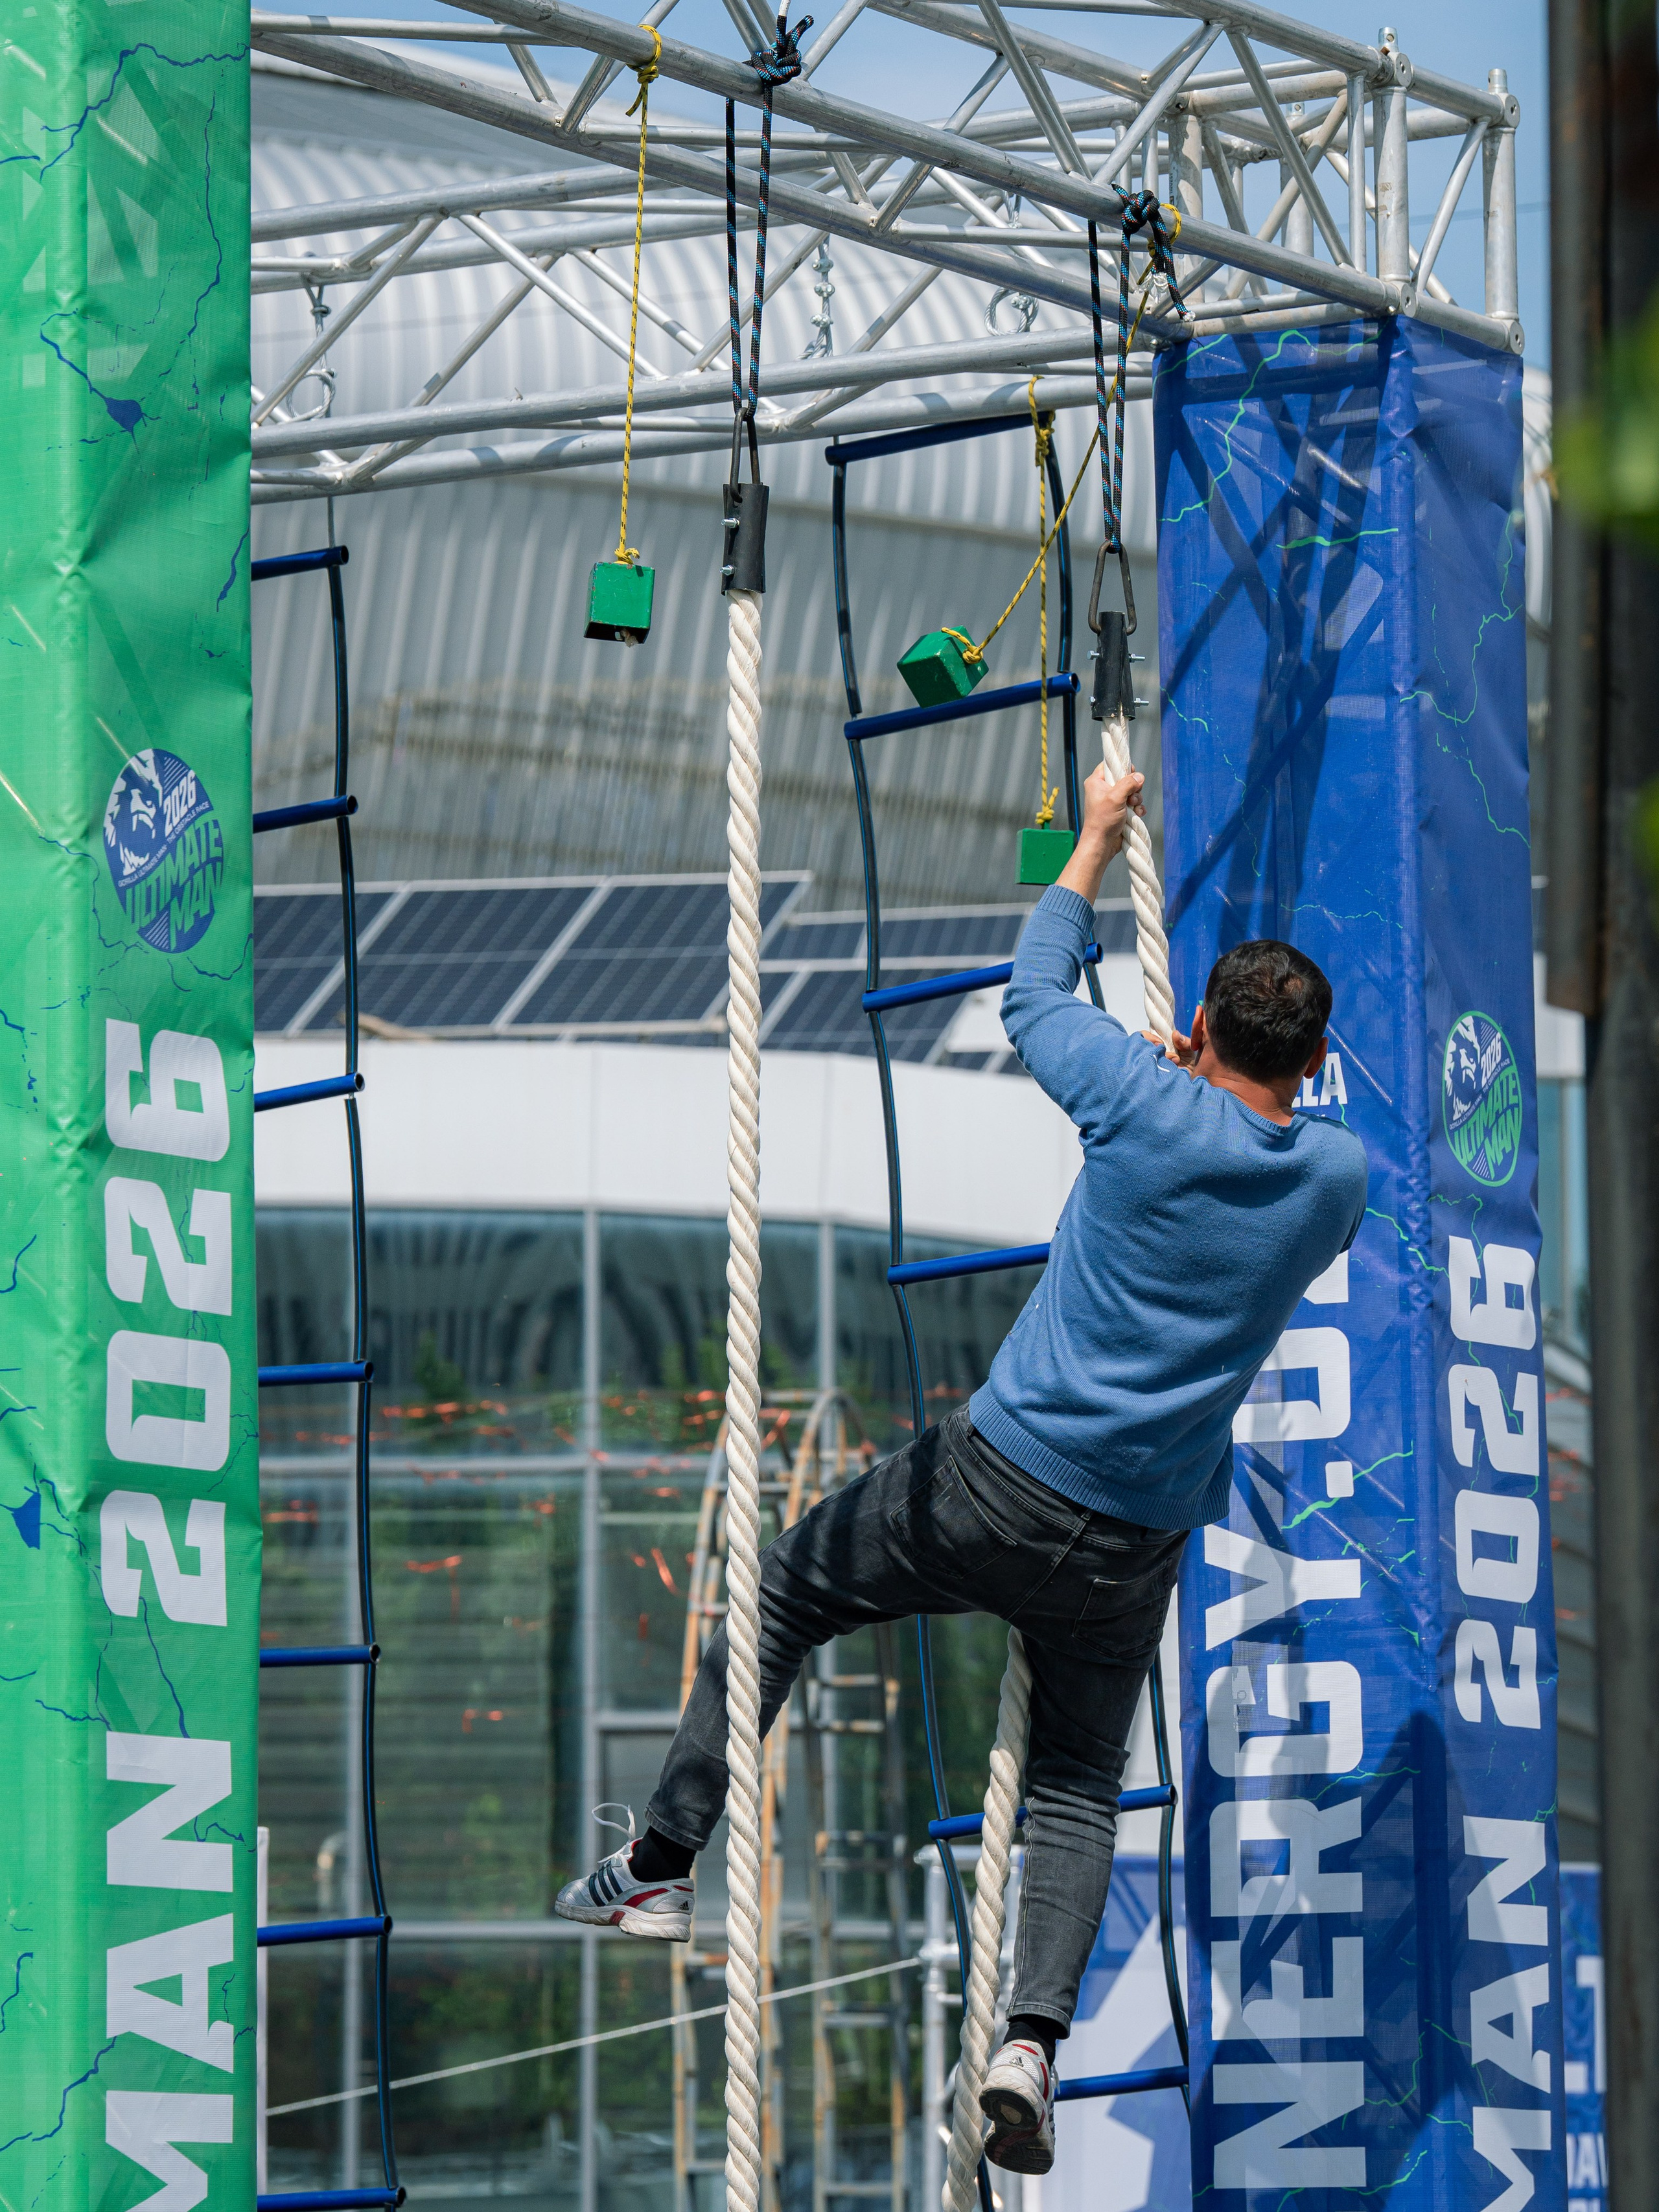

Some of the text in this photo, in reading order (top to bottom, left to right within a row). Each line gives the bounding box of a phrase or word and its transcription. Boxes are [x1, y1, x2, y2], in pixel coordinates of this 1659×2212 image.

[118, 873, 138, 888] GORILLA
[167, 833, 176, 844] THE
[174, 809, 197, 834] OBSTACLE
[195, 800, 210, 813] RACE
[163, 769, 196, 837] 2026
[125, 810, 223, 931] ULTIMATE
[169, 861, 222, 951] MAN
[1291, 1052, 1348, 1108] LA
[1481, 1032, 1502, 1088] 2026
[1454, 1064, 1519, 1165] ULTIMATE
[1484, 1107, 1520, 1181] MAN
[100, 1018, 234, 2212] MAN 2026
[1447, 1235, 1551, 2212] MAN 2026
